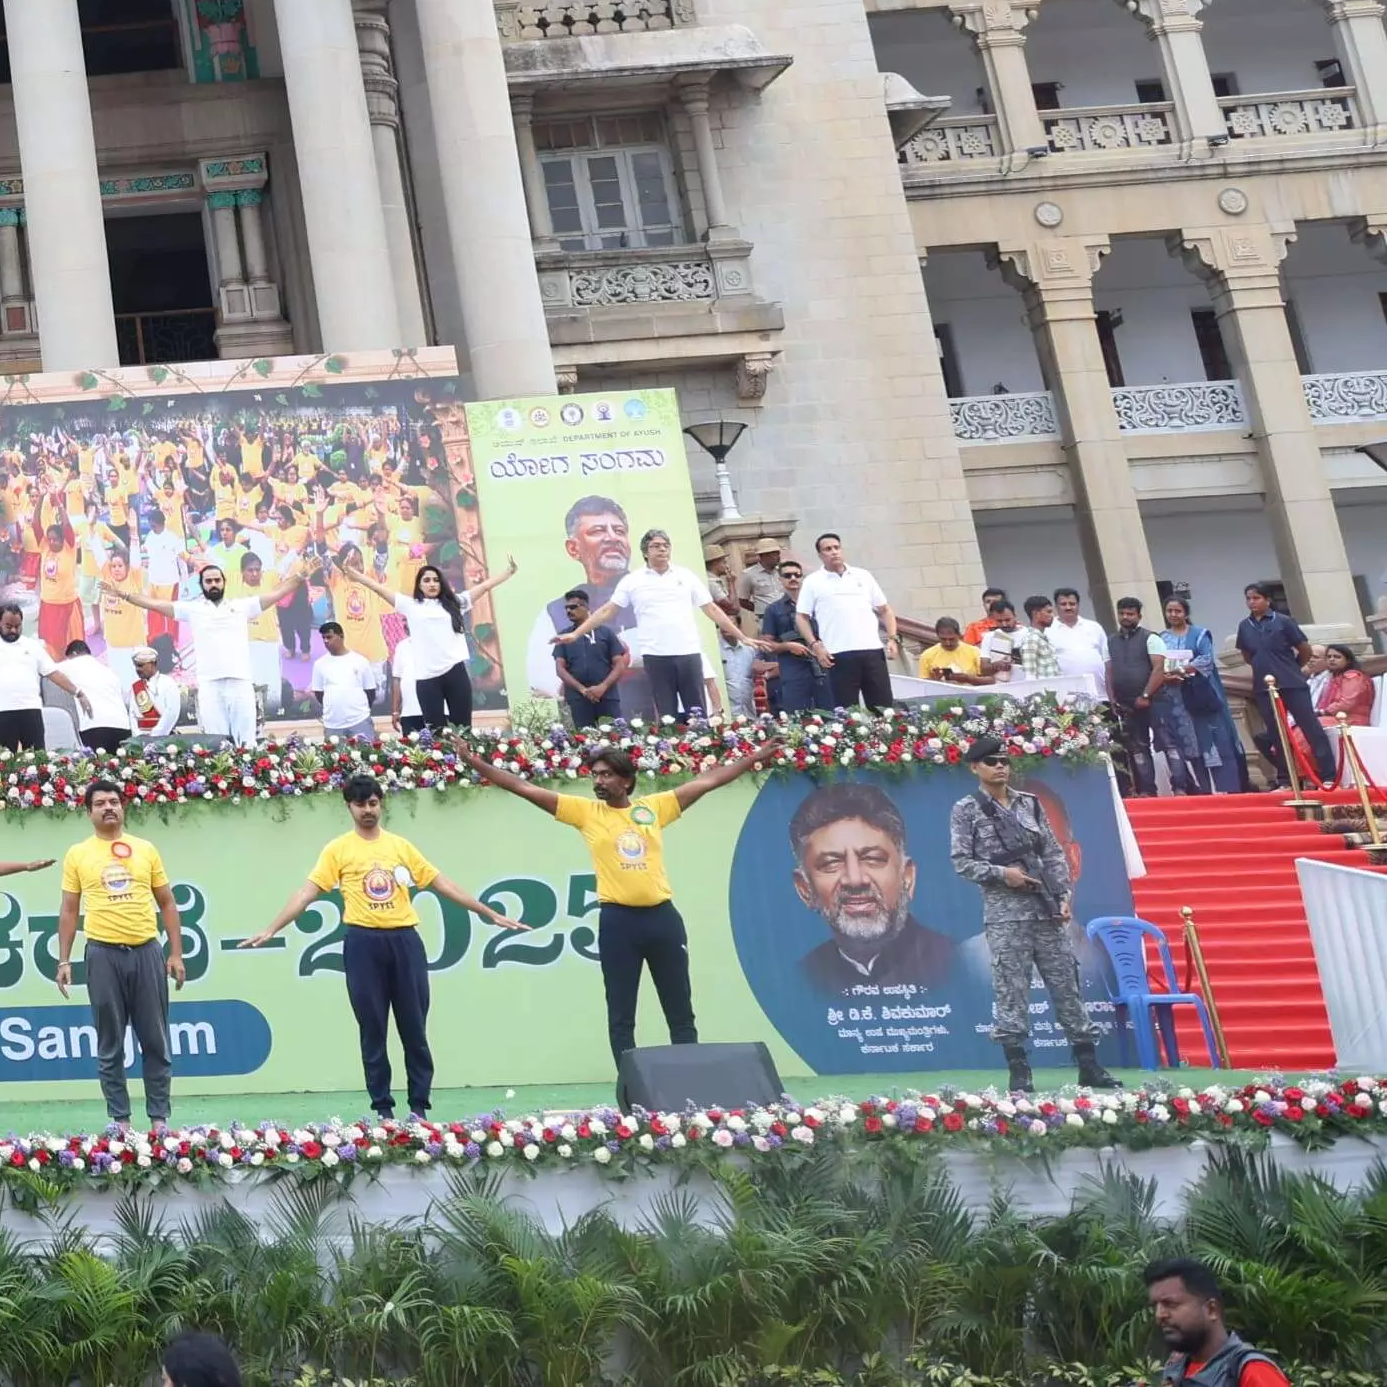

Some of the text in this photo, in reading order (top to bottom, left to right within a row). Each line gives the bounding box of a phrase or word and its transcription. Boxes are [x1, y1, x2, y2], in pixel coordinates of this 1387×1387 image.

[562, 431, 618, 443] DEPARTMENT
[633, 429, 661, 437] AYUSH
[490, 449, 665, 478] ಯೋಗ ಸಂಗಮ
[851, 984, 880, 996] ಗೌರವ
[827, 1008, 844, 1025] ಶ್ರೀ
[882, 1003, 952, 1020] ಶಿವಕುಮಾರ್
